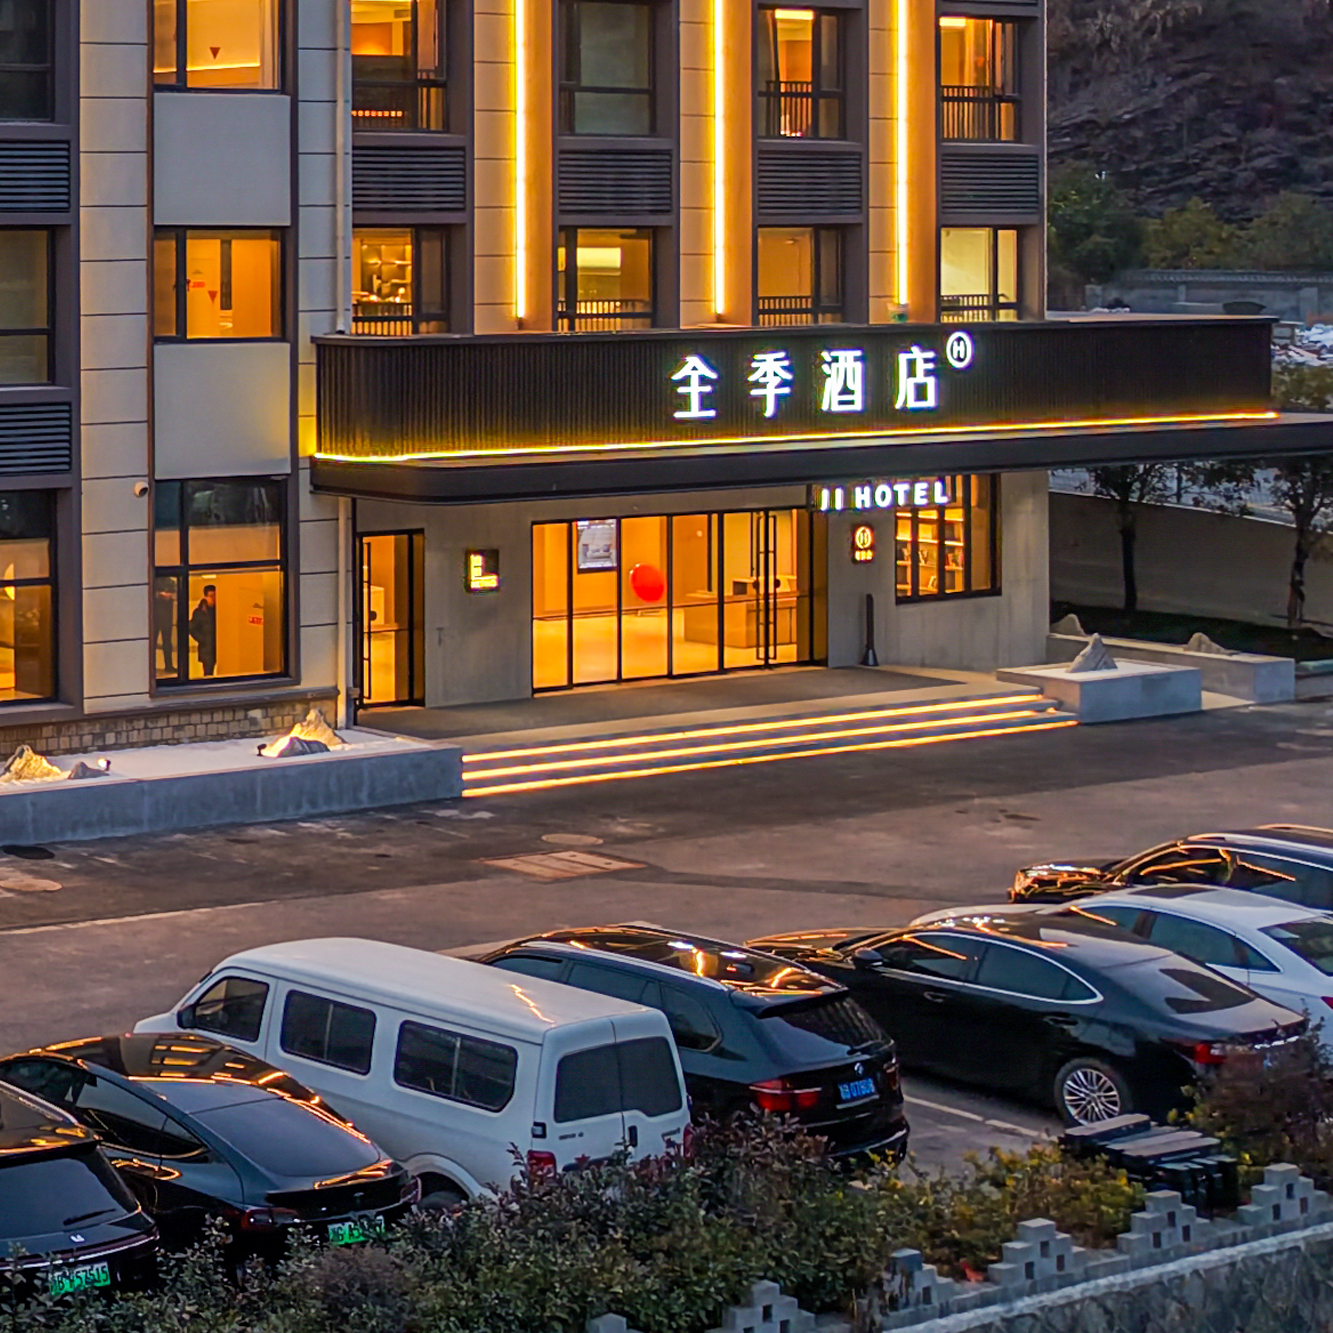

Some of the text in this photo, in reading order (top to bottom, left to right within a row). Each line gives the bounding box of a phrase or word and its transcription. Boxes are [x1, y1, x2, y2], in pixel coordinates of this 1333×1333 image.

[671, 345, 937, 418] 全季酒店
[820, 480, 949, 511] JI HOTEL
